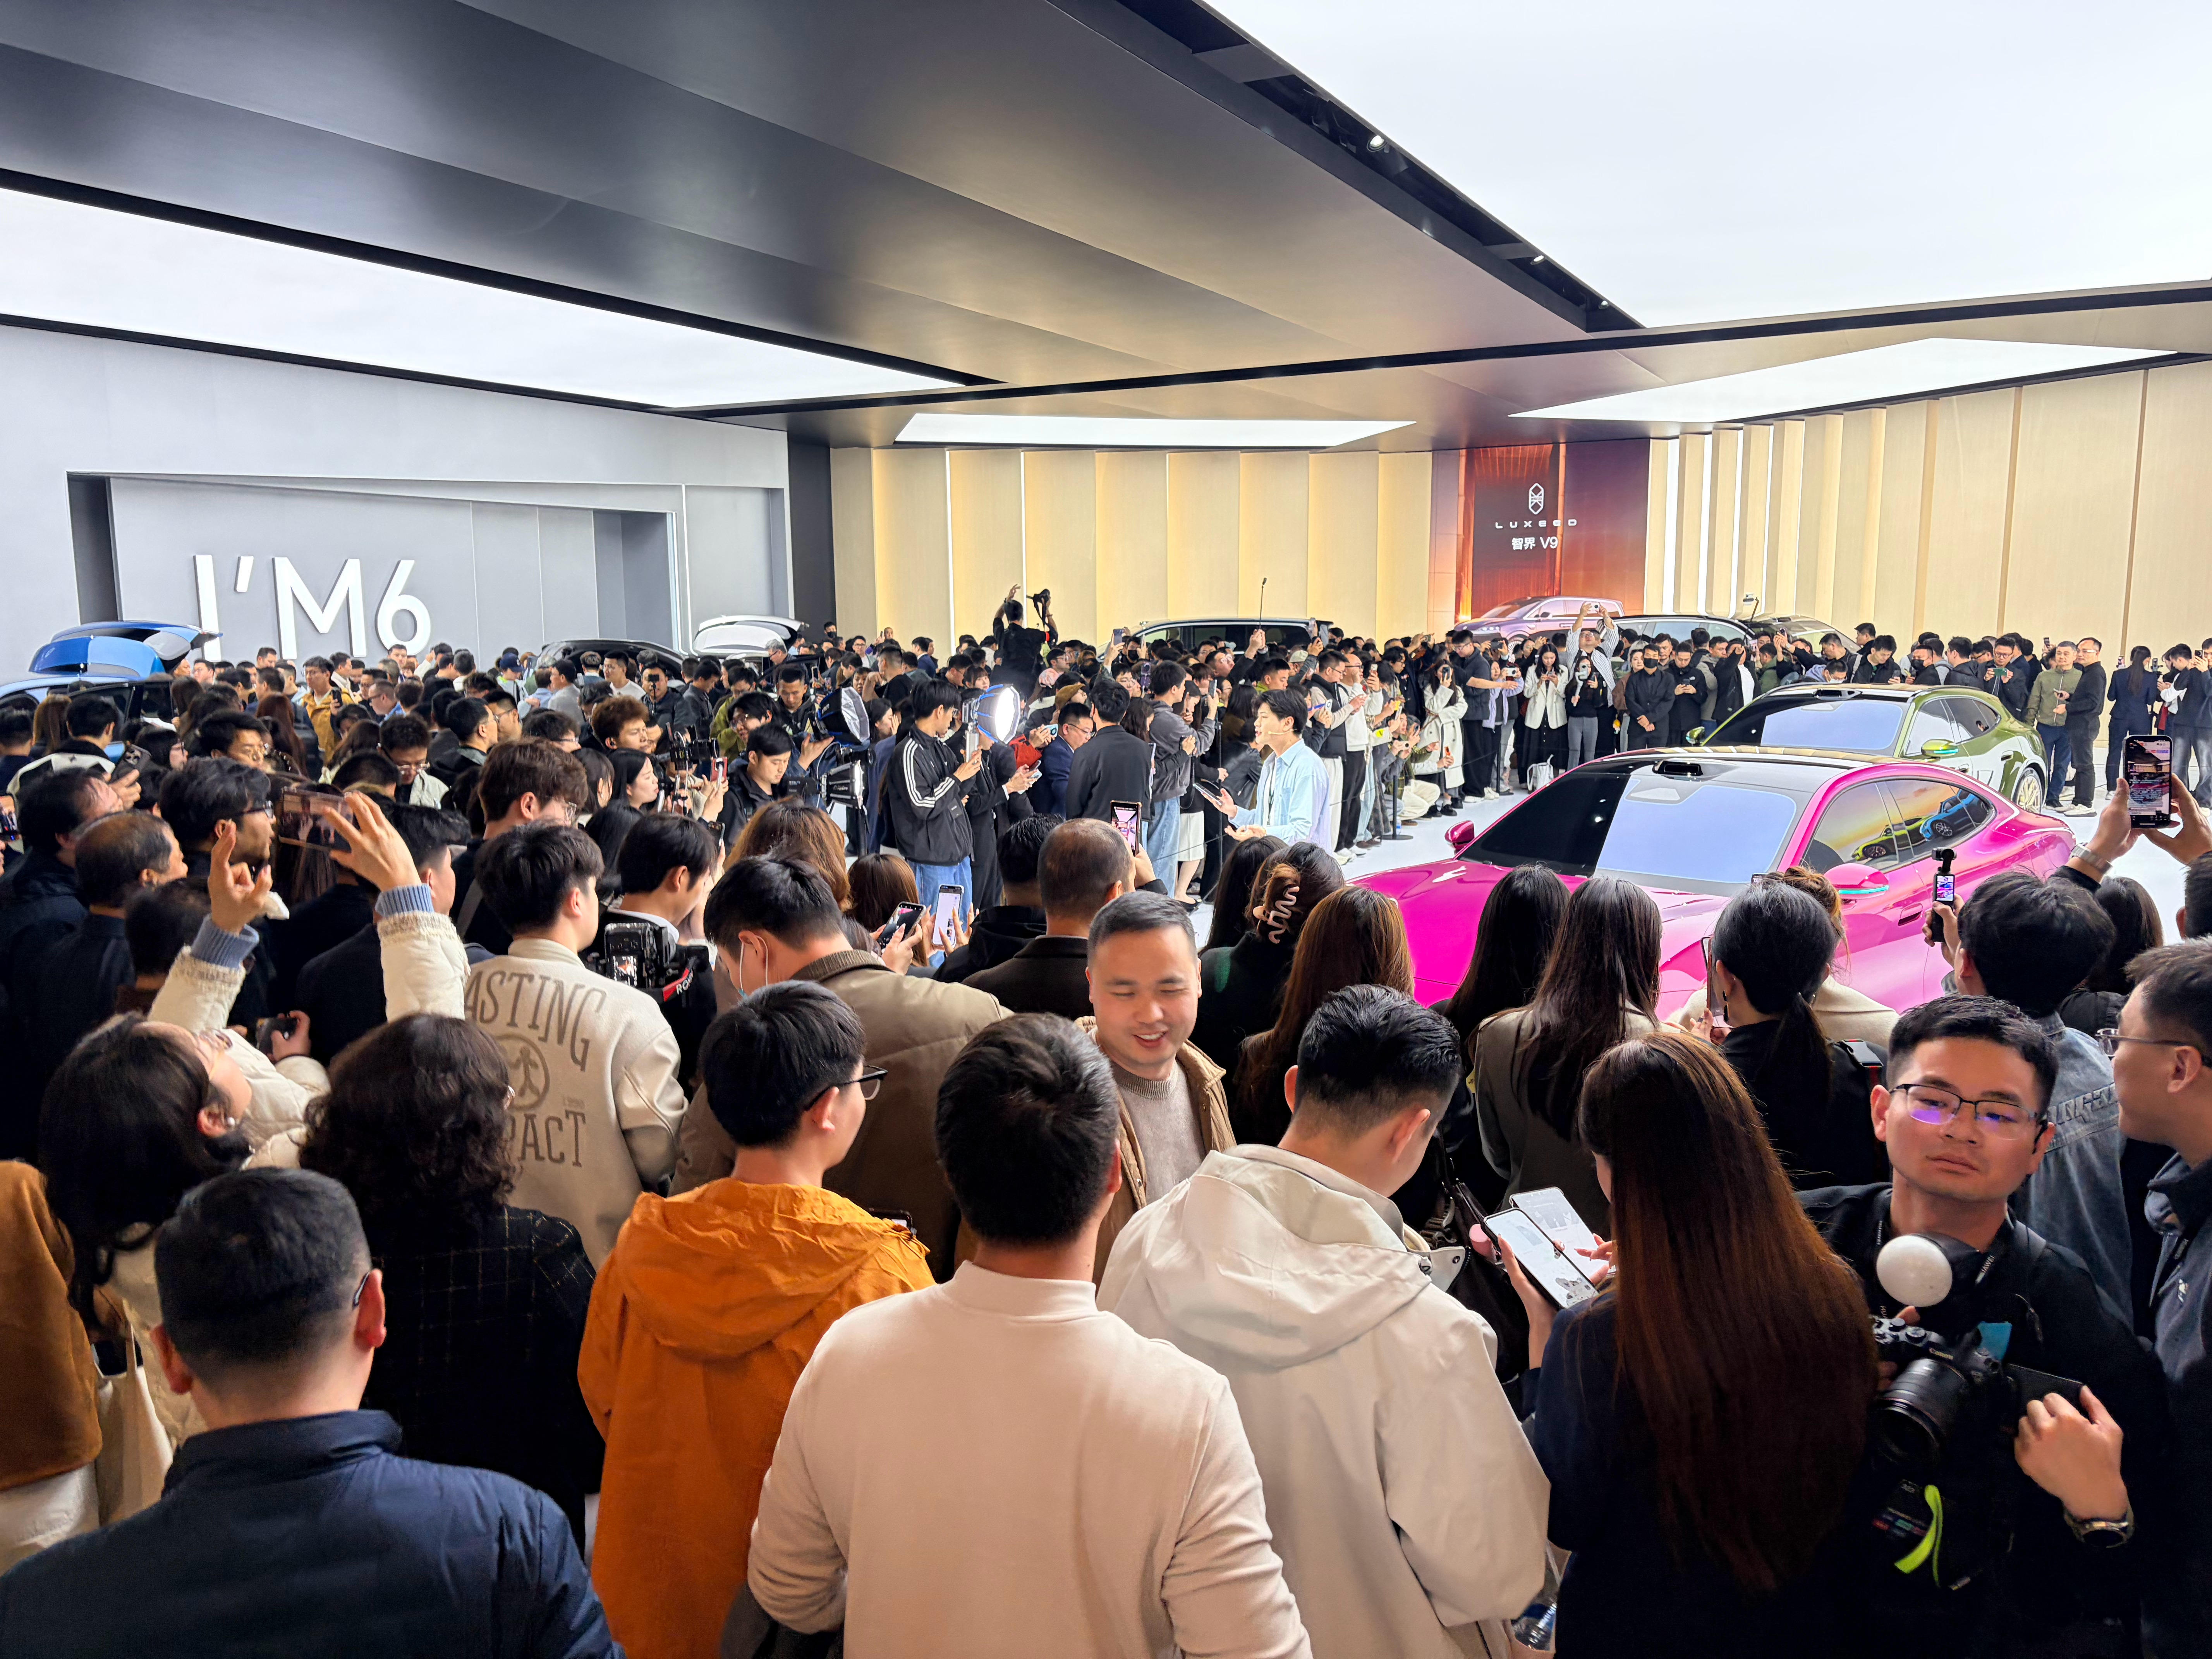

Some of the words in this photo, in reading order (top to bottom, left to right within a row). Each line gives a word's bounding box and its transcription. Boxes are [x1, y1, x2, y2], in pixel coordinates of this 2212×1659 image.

[1495, 519, 1577, 529] LUXEED
[1511, 537, 1536, 550] 智界
[1540, 536, 1558, 549] V9
